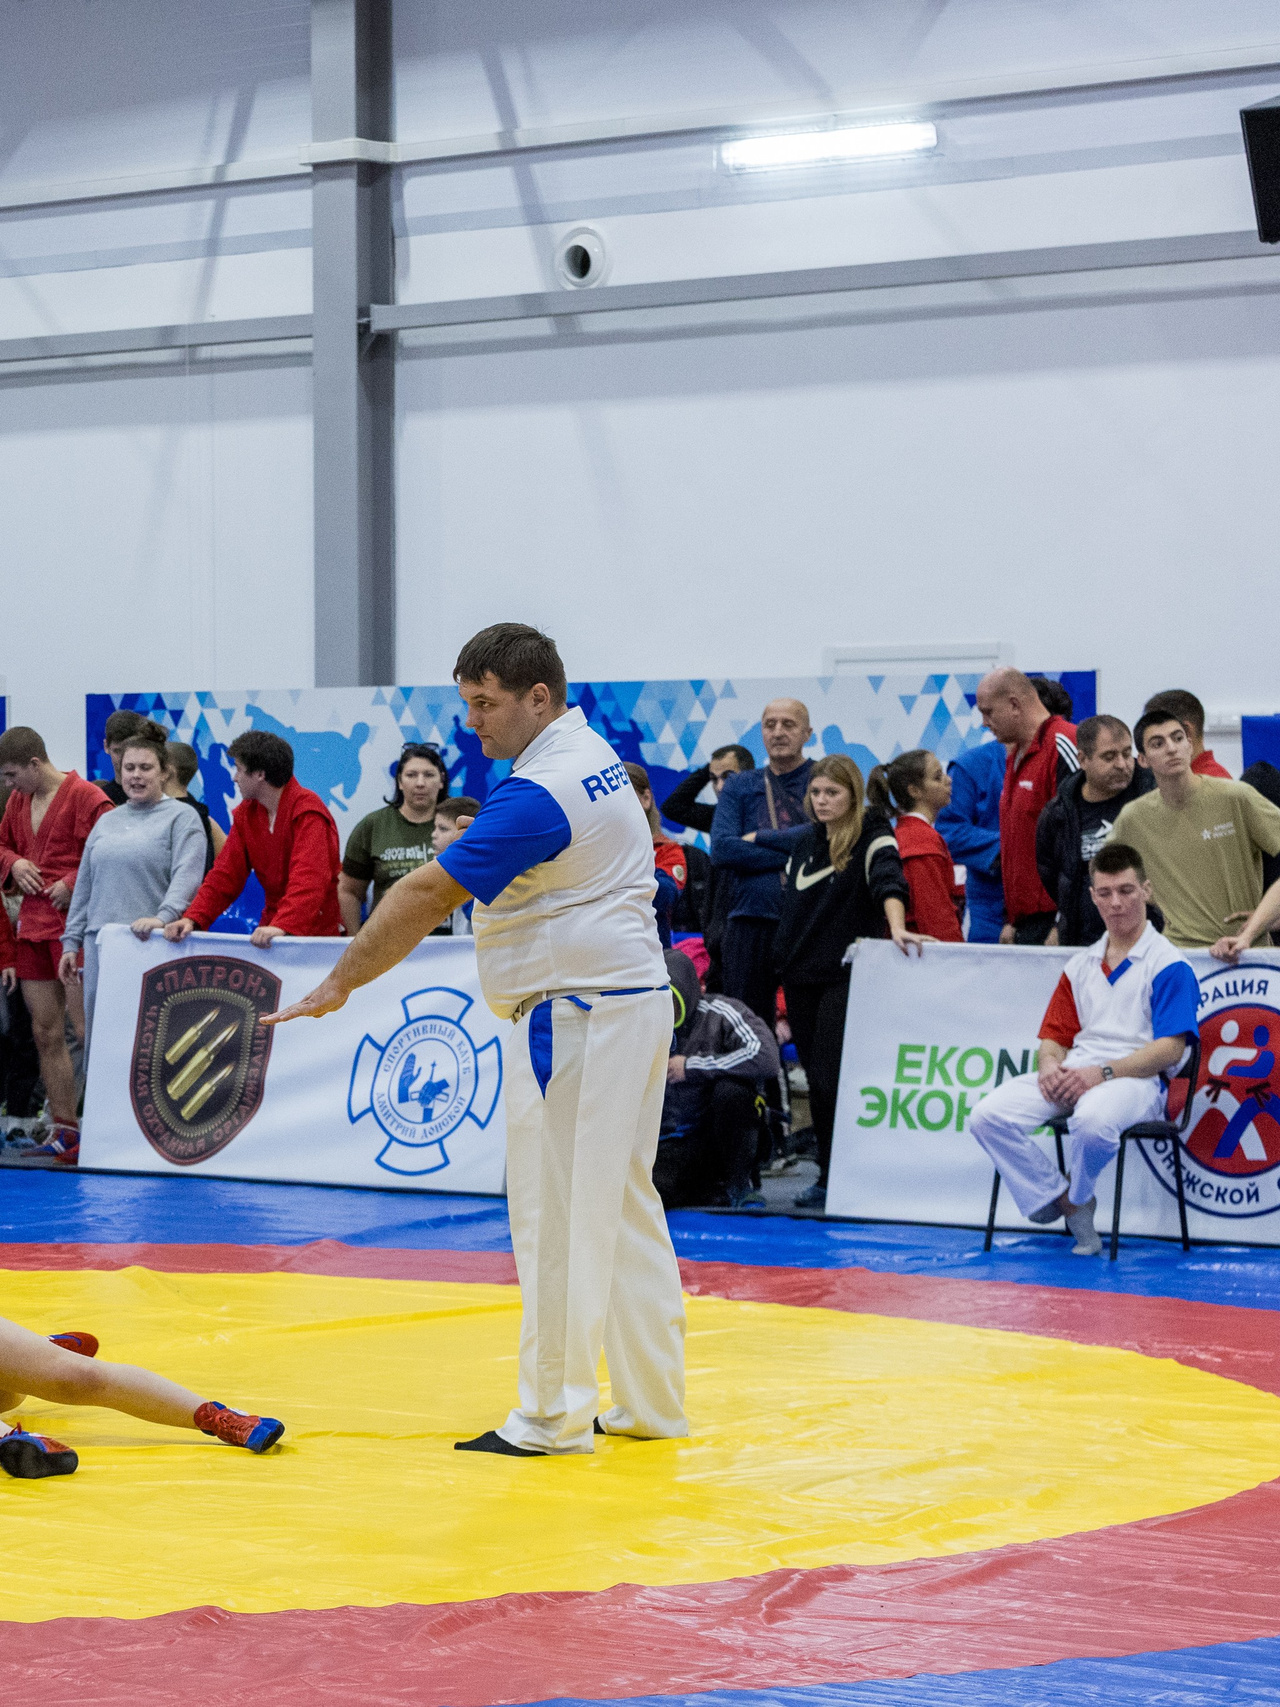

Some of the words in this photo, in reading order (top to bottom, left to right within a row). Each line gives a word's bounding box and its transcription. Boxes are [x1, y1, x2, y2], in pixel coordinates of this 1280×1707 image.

[581, 761, 631, 803] REFE
[1199, 979, 1269, 1008] РАЦИЯ
[137, 1005, 158, 1098] ЧАСТНАЯ
[383, 1023, 456, 1073] СПОРТИВНЫЙ
[894, 1043, 1039, 1088] EKON
[143, 1104, 206, 1156] ОХРАННАЯ
[376, 1092, 417, 1139] ДМИТРИЙ
[420, 1097, 467, 1141] ДОНСКОЙ
[856, 1086, 1054, 1137] ЭКОН
[1153, 1137, 1260, 1205] ОНЖСКОЙ
